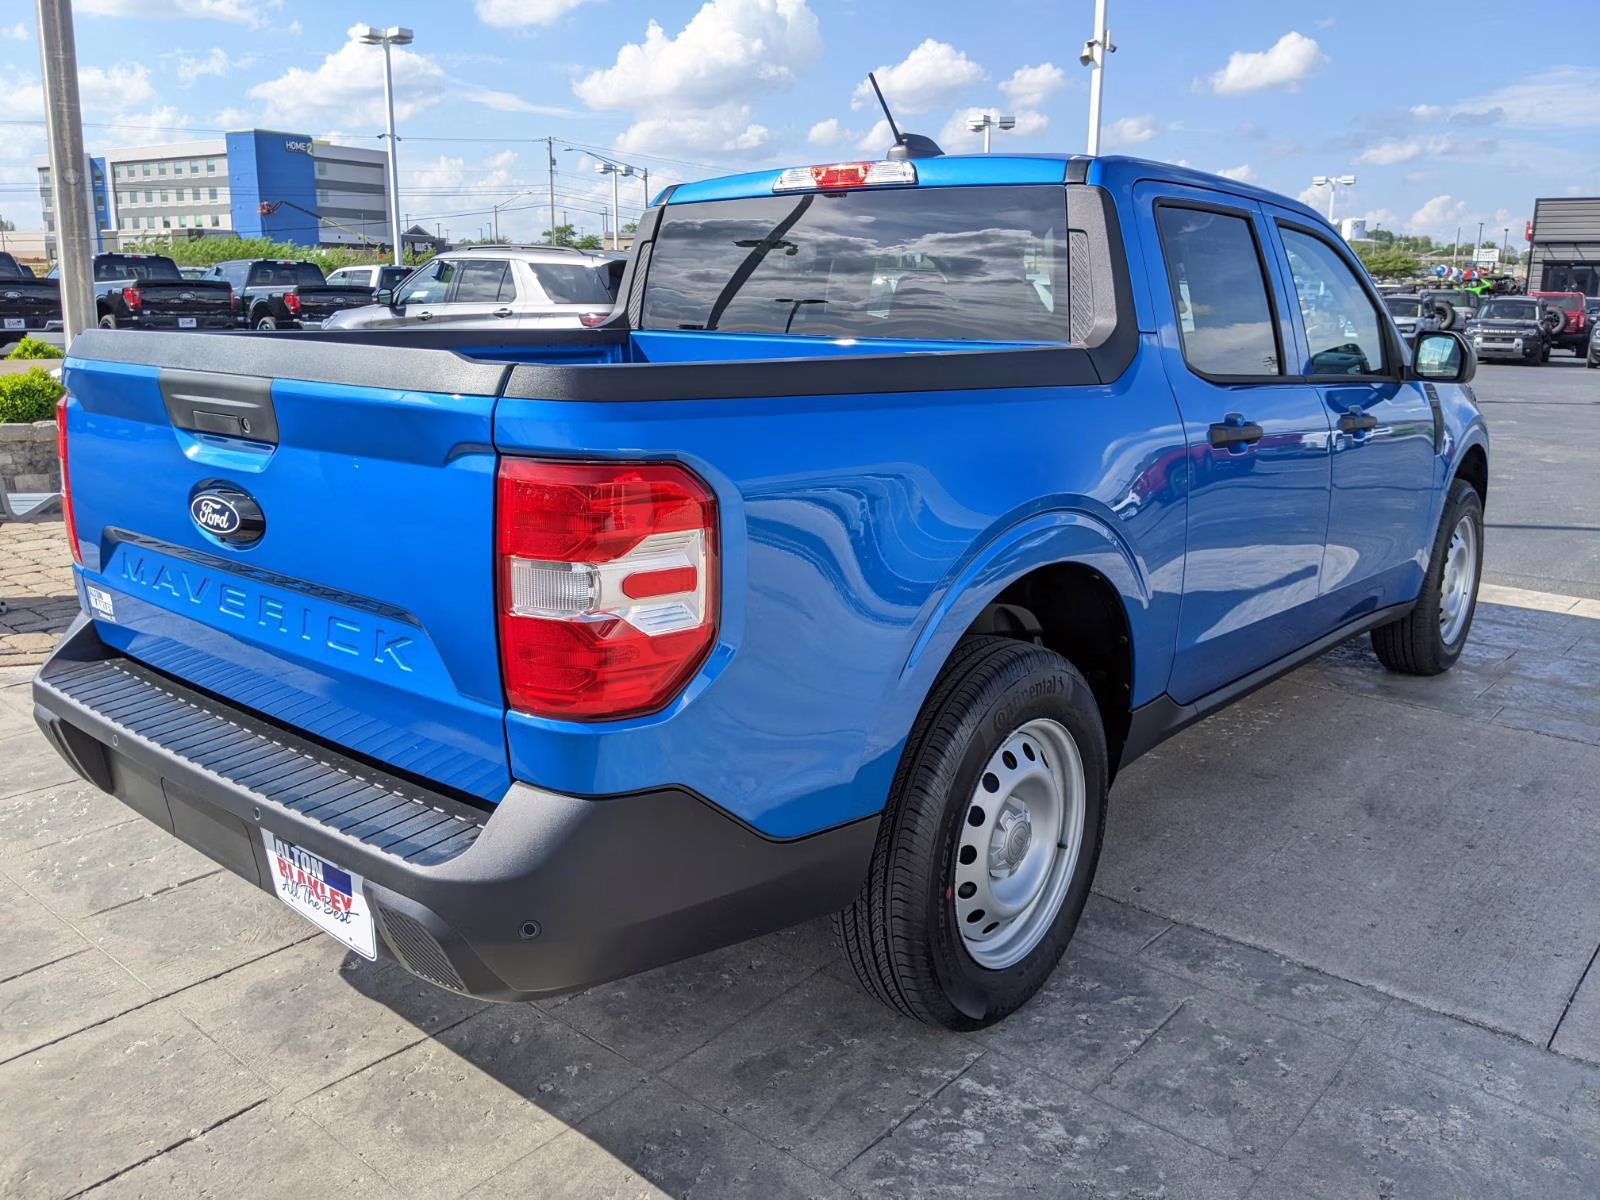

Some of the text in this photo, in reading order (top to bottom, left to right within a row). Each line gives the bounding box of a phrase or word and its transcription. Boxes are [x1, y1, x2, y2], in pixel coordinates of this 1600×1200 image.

[199, 500, 229, 529] Ford
[122, 551, 413, 672] MAVERICK
[275, 839, 324, 882] ALTON
[282, 874, 359, 924] All The Best
